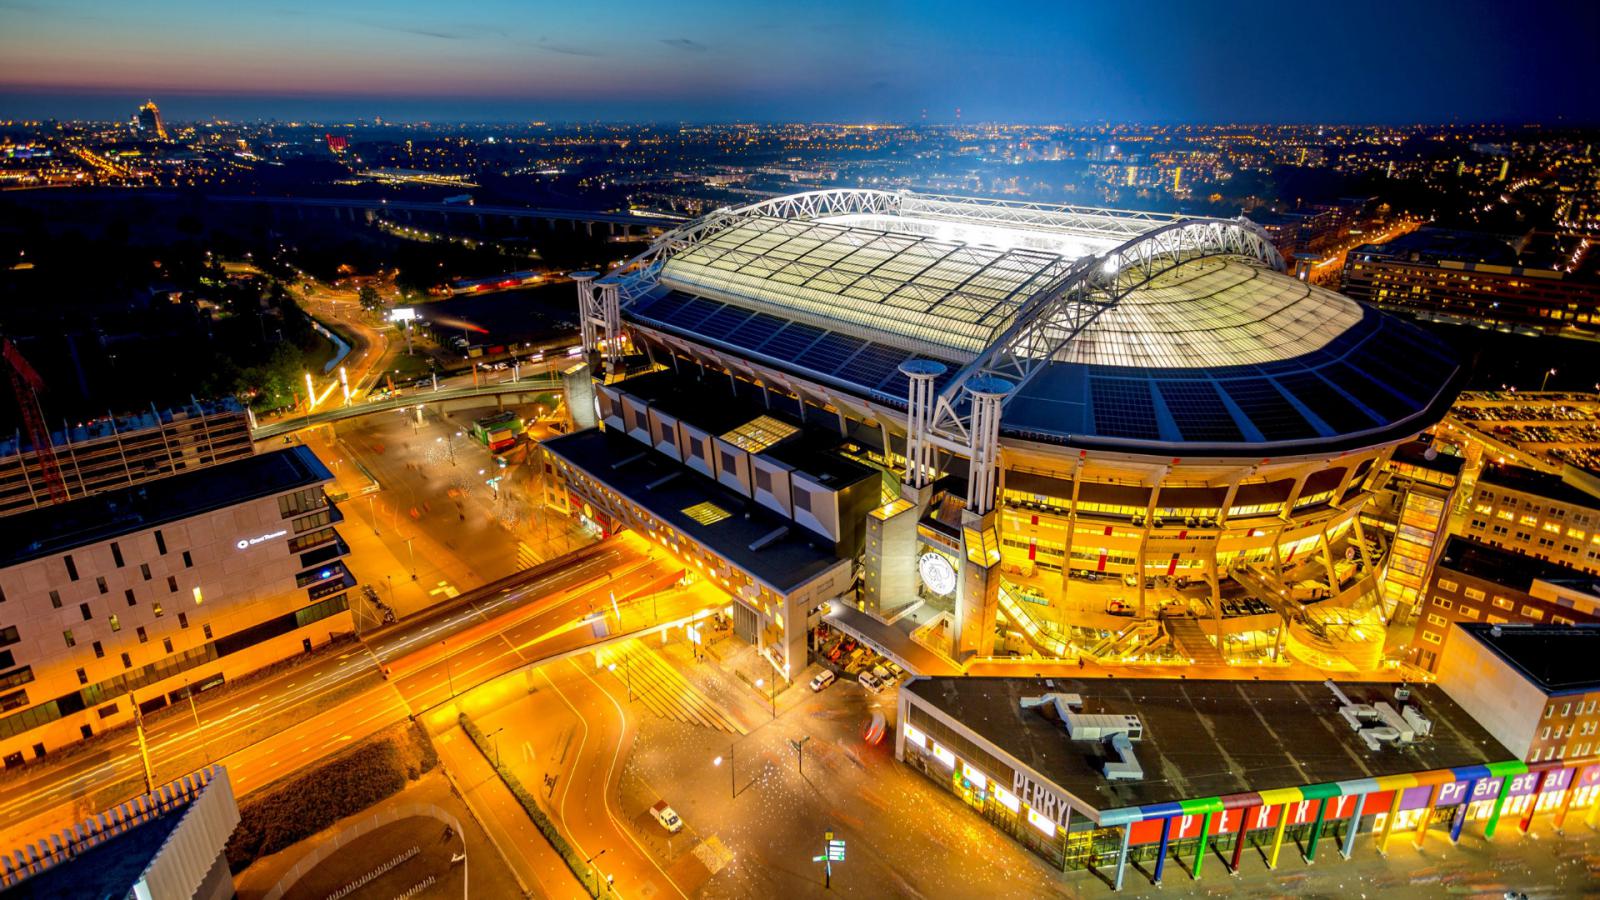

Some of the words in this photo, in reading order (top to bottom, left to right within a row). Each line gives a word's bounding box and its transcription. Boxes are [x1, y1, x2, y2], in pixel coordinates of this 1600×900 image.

[1012, 769, 1067, 826] PERRY
[1439, 767, 1565, 801] Prénatal
[1178, 794, 1348, 838] PERRY
